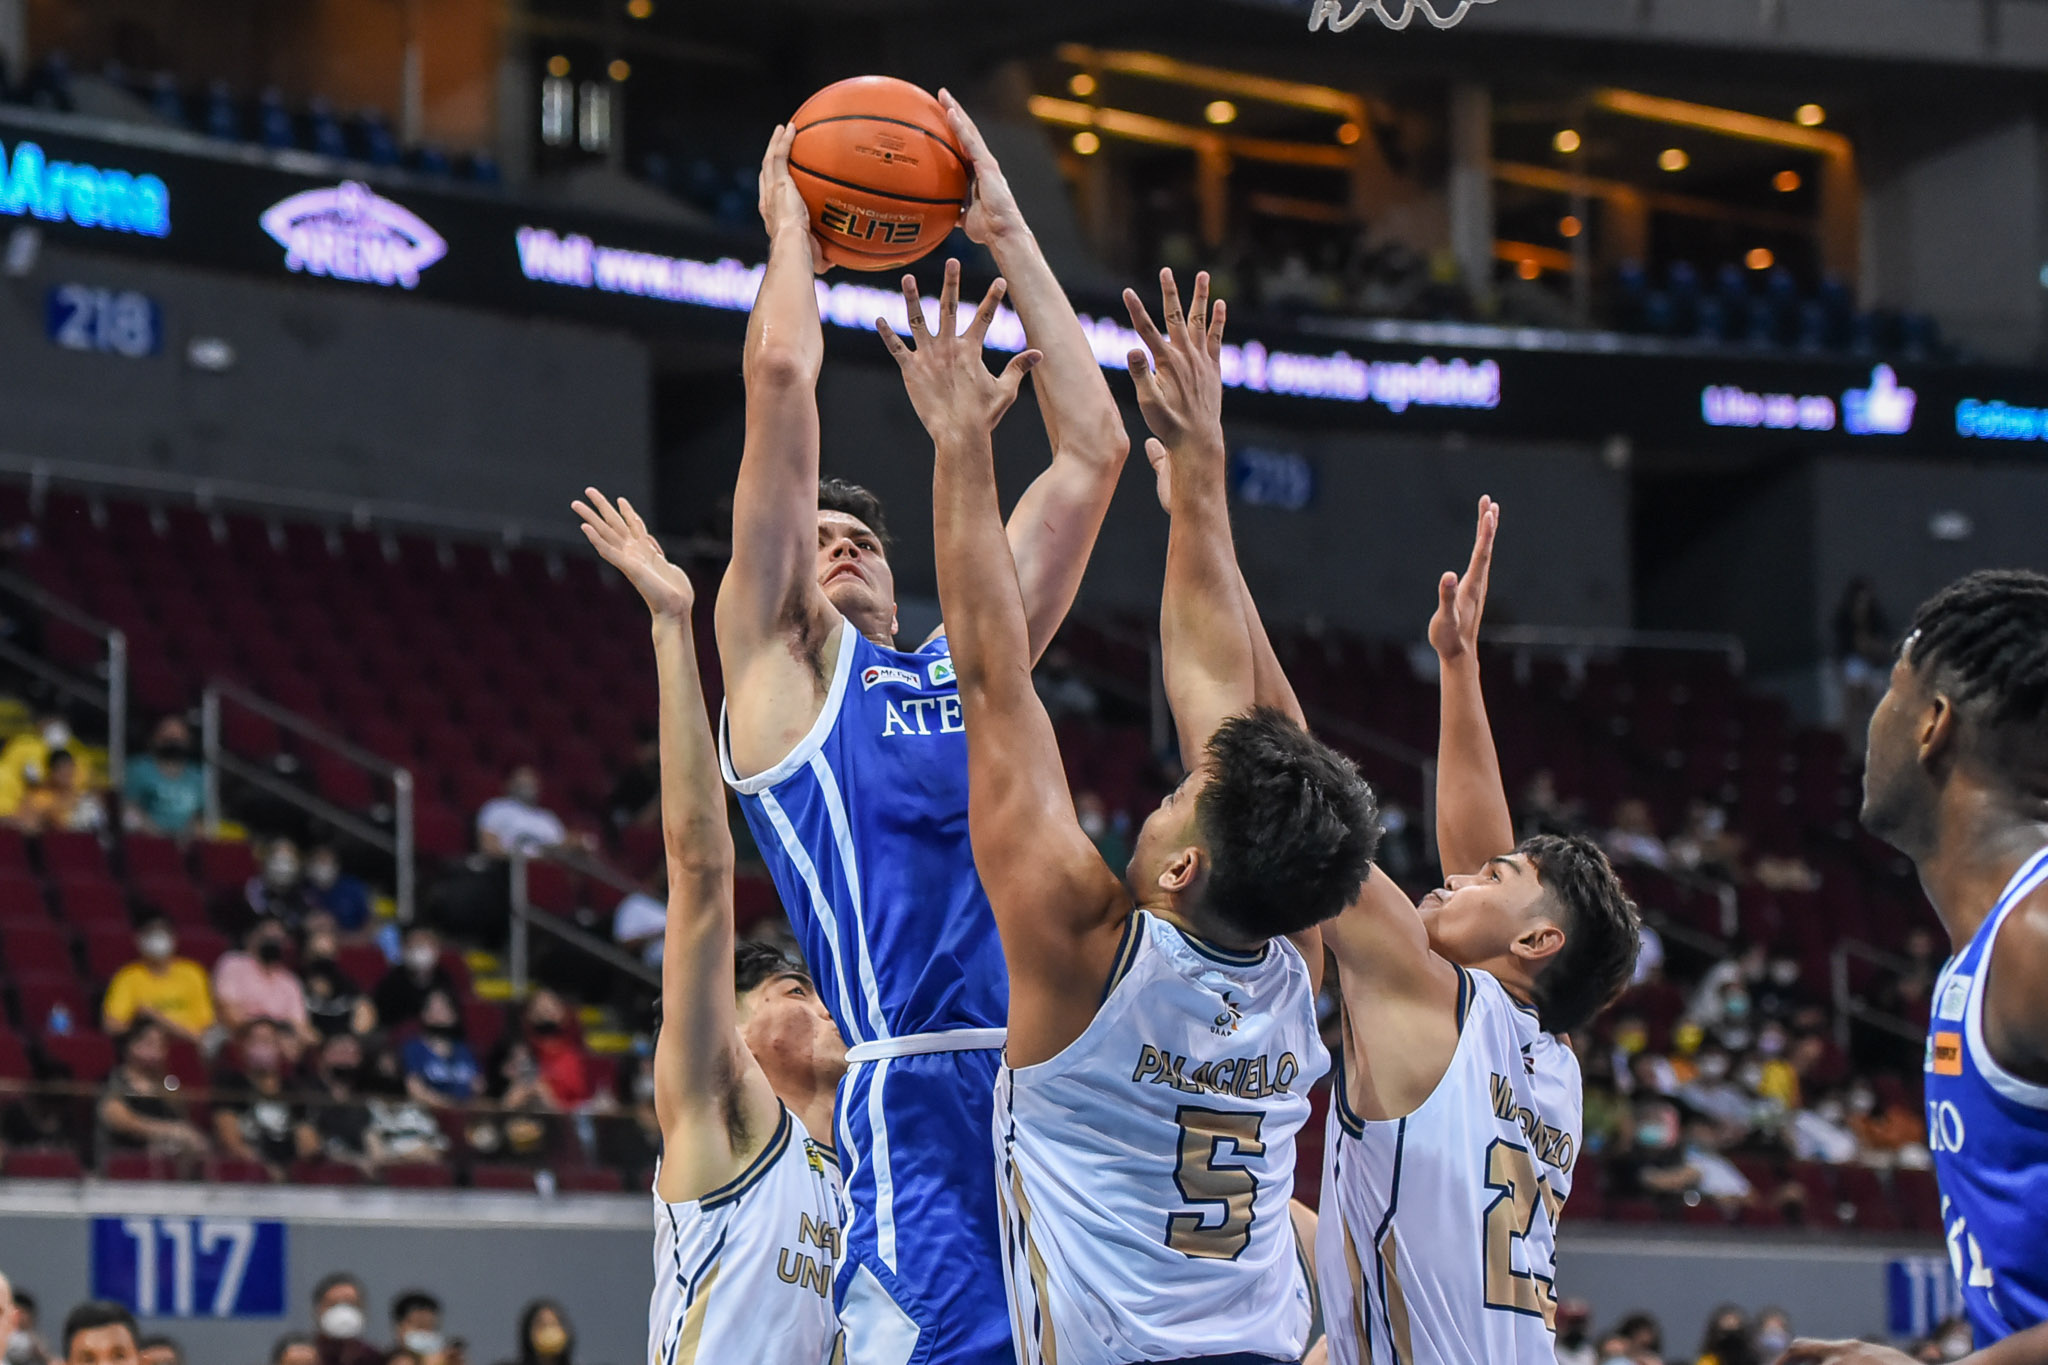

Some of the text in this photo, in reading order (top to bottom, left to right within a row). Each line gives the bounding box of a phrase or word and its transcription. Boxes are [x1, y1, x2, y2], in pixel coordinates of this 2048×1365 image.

[0, 139, 171, 238] Arena
[821, 203, 924, 245] ELITE
[57, 283, 153, 355] 218
[1210, 1026, 1232, 1037] UAAP
[1132, 1044, 1299, 1099] PALACIELO
[1164, 1104, 1267, 1262] 5
[121, 1215, 258, 1318] 117
